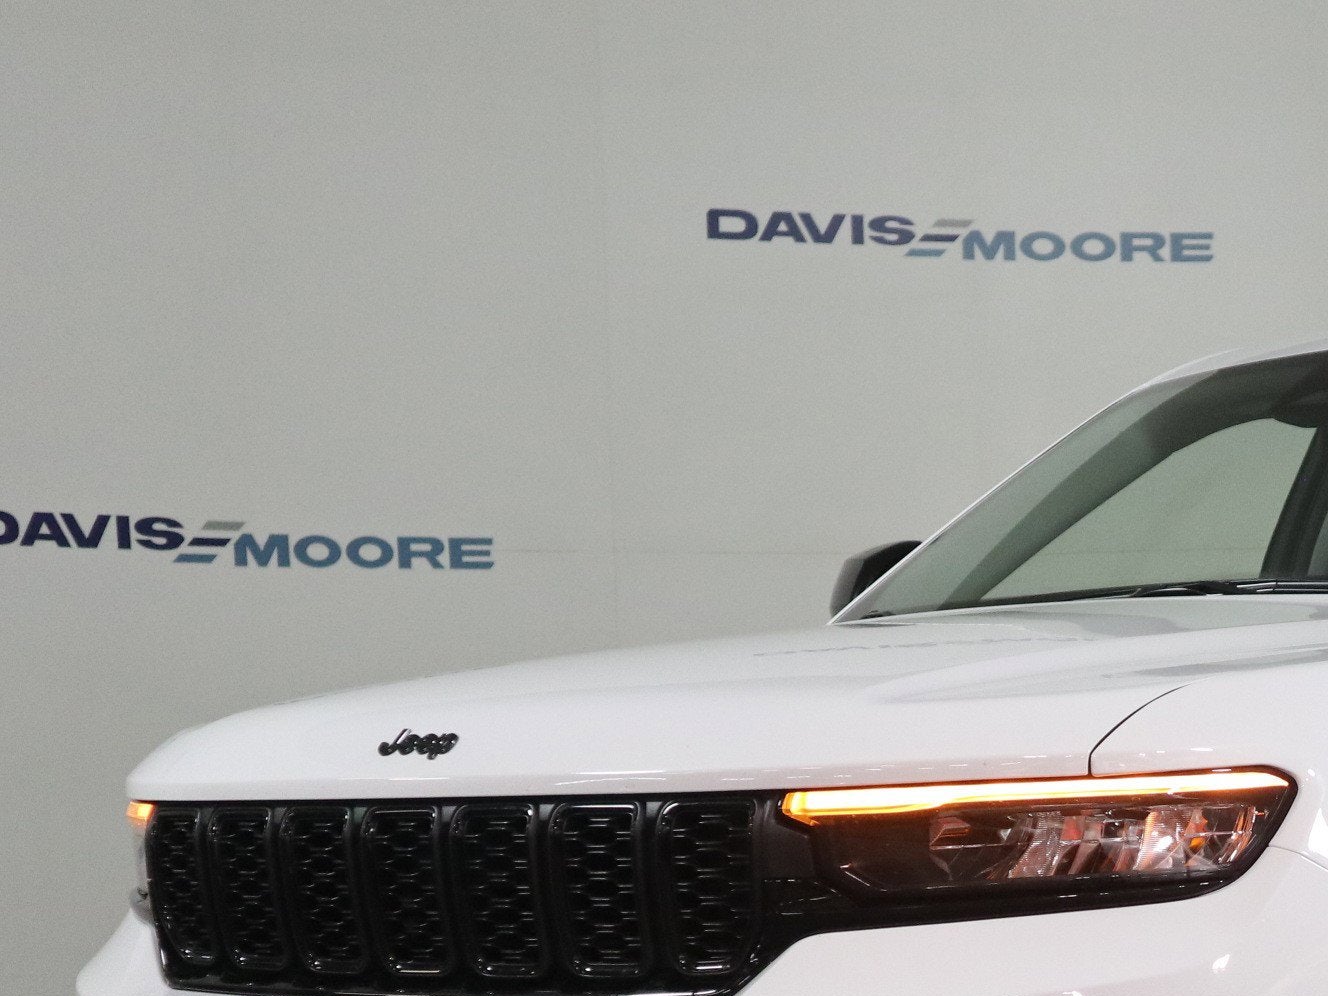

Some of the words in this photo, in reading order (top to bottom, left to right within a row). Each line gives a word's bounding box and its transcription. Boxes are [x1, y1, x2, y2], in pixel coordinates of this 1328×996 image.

[706, 207, 916, 246] DAVIS
[961, 229, 1214, 263] MOORE
[233, 532, 495, 570] MOORE
[377, 728, 460, 760] Jeep
